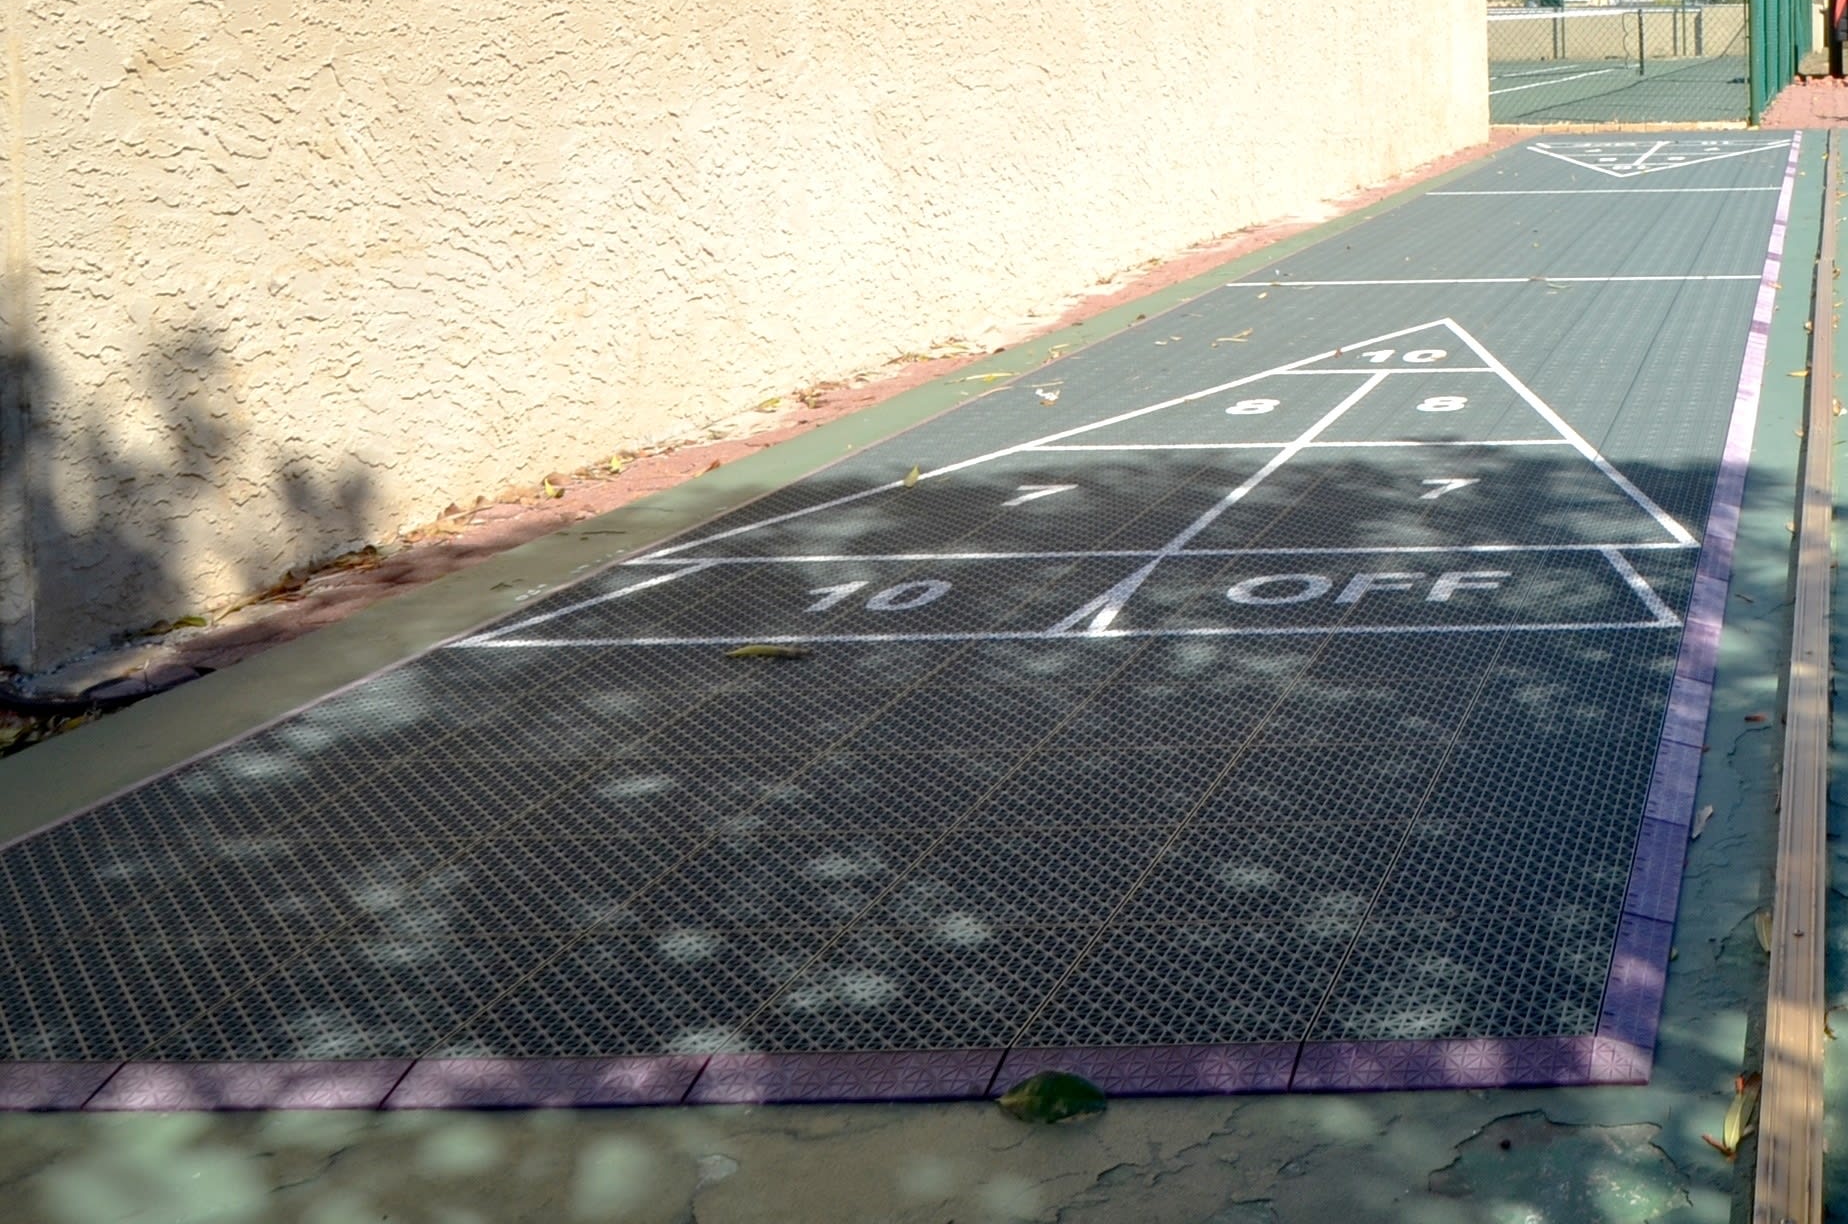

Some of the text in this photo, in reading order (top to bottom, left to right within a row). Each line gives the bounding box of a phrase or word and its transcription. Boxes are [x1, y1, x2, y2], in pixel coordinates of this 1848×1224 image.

[1358, 349, 1447, 363] 10
[1225, 398, 1280, 415] 8
[1415, 394, 1468, 413] 8
[1001, 484, 1077, 506] 7
[1420, 477, 1480, 499] 7
[804, 579, 953, 611] 10
[1226, 571, 1513, 604] OFF
